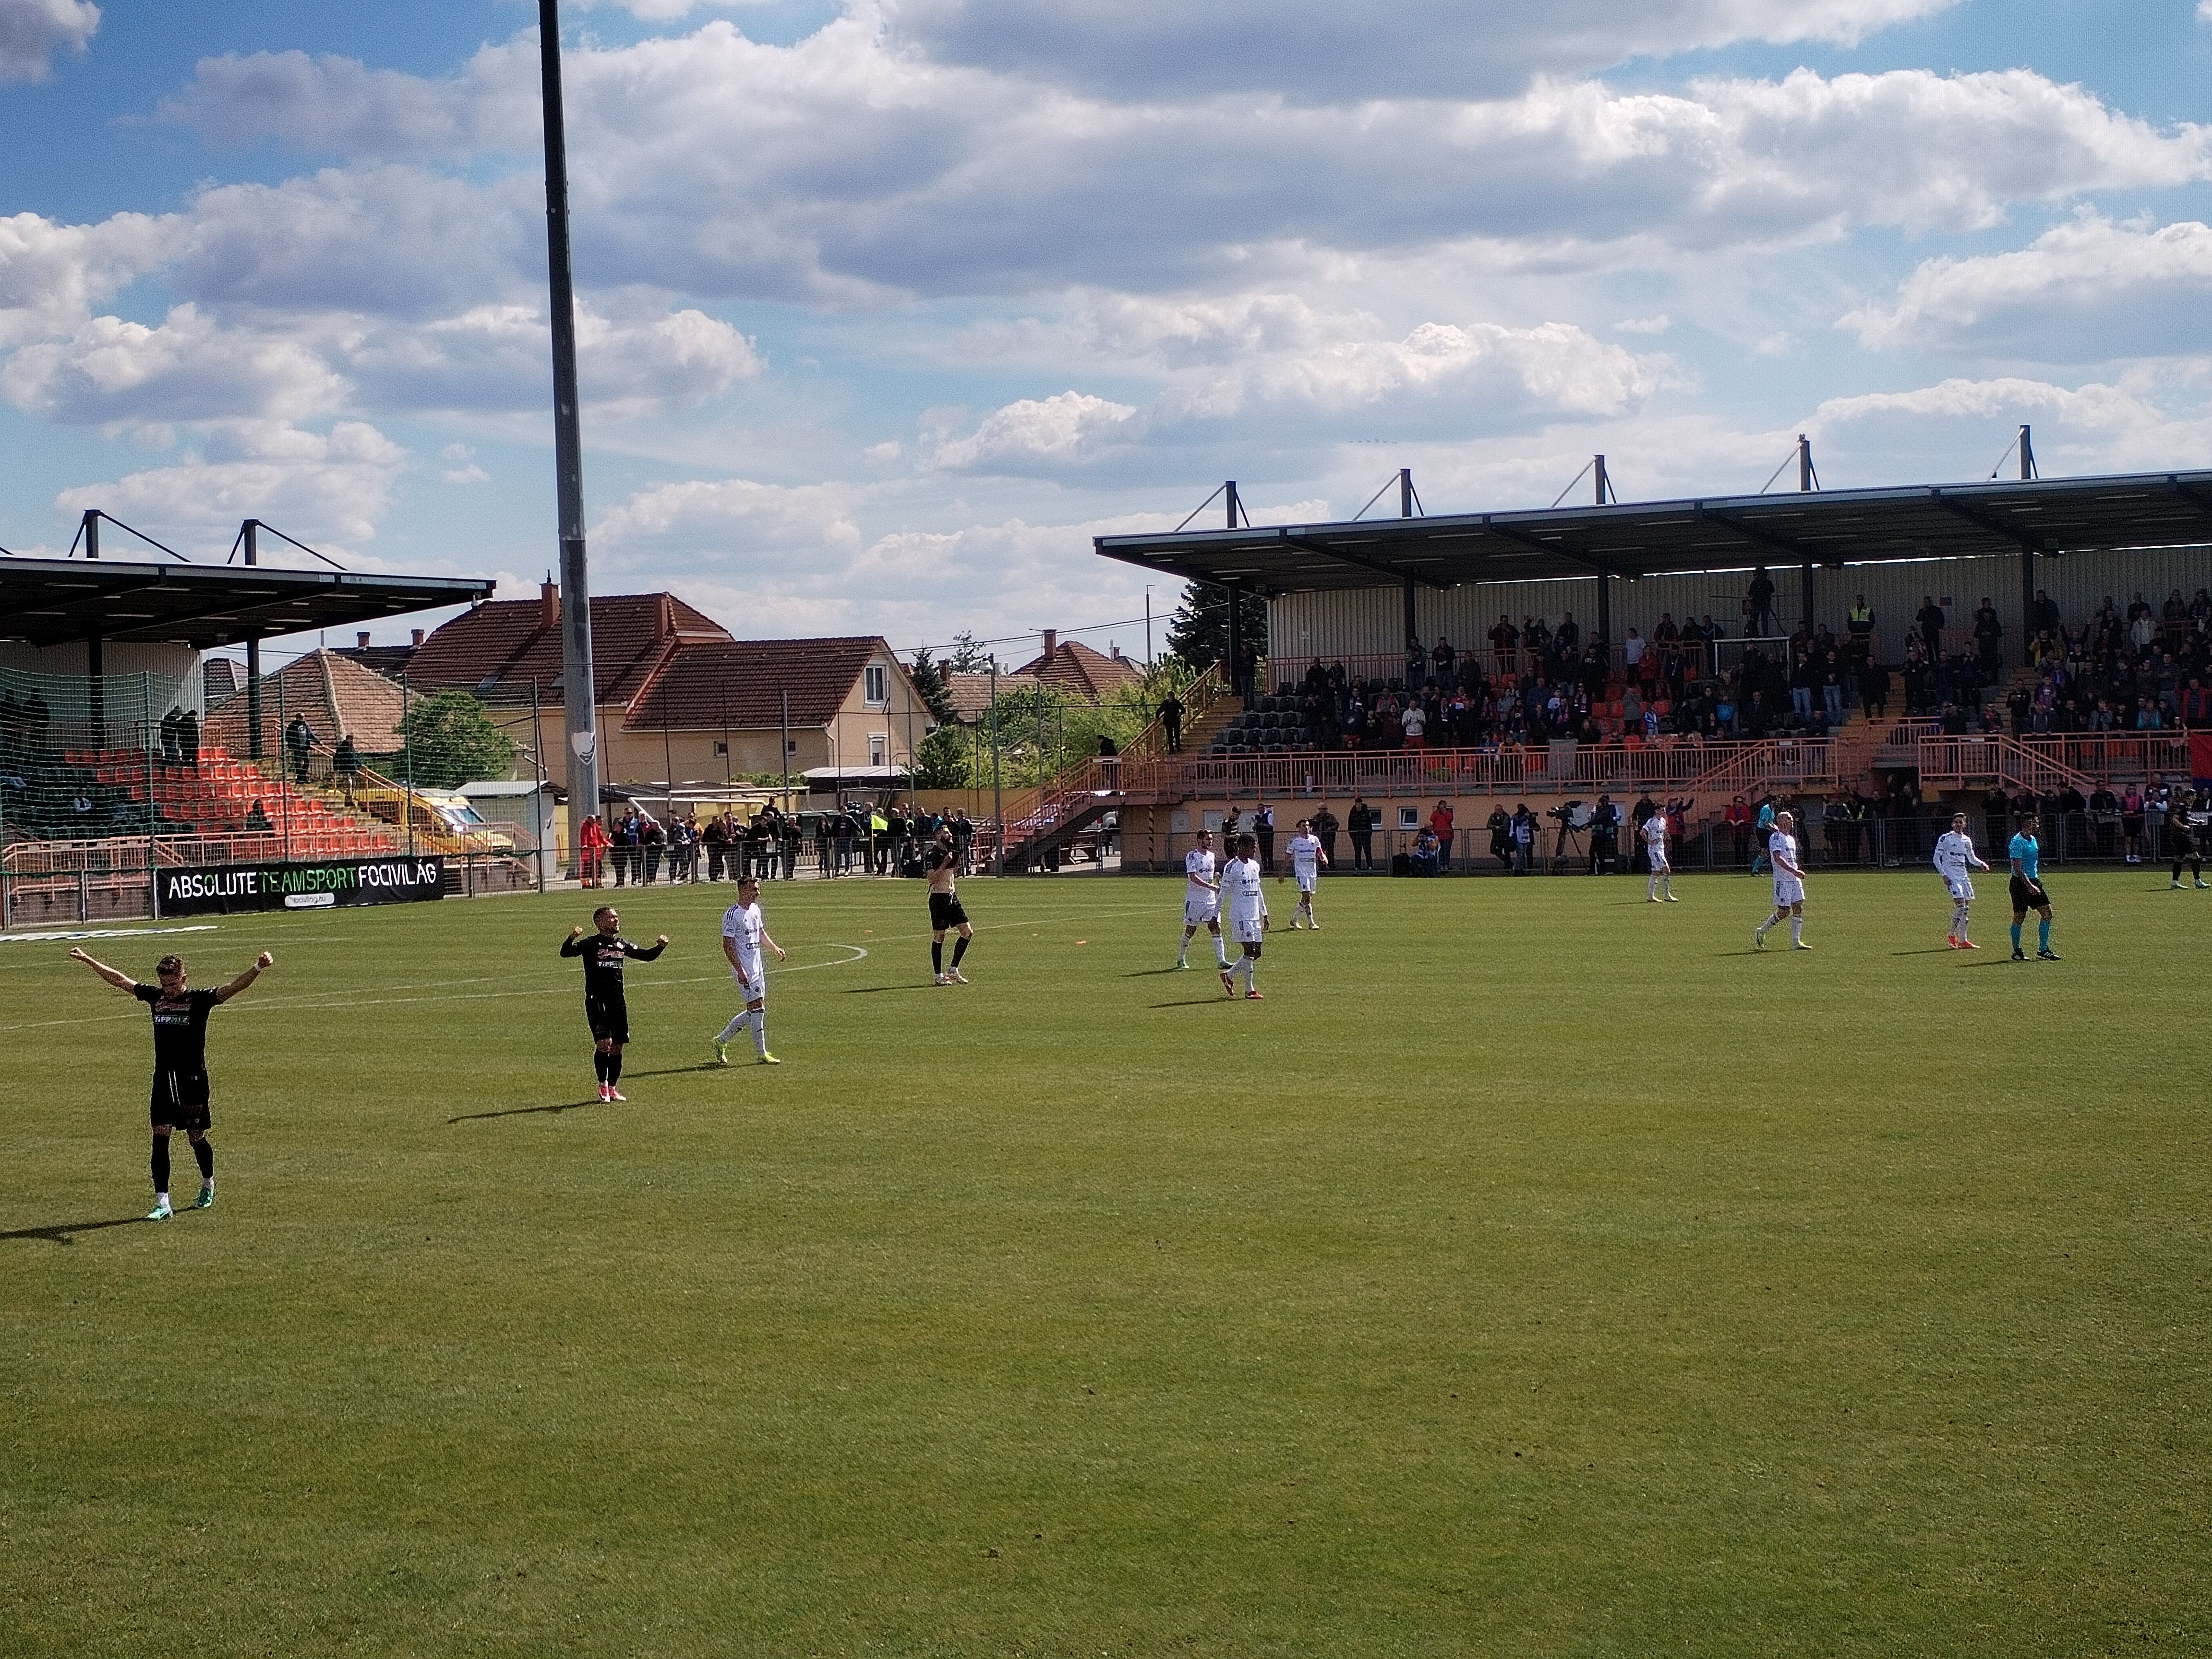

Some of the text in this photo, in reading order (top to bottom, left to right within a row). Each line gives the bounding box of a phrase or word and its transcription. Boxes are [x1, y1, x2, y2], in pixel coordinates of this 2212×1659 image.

[168, 859, 436, 899] ABSOLUTE TEAMSPORT FOCIVILÁG
